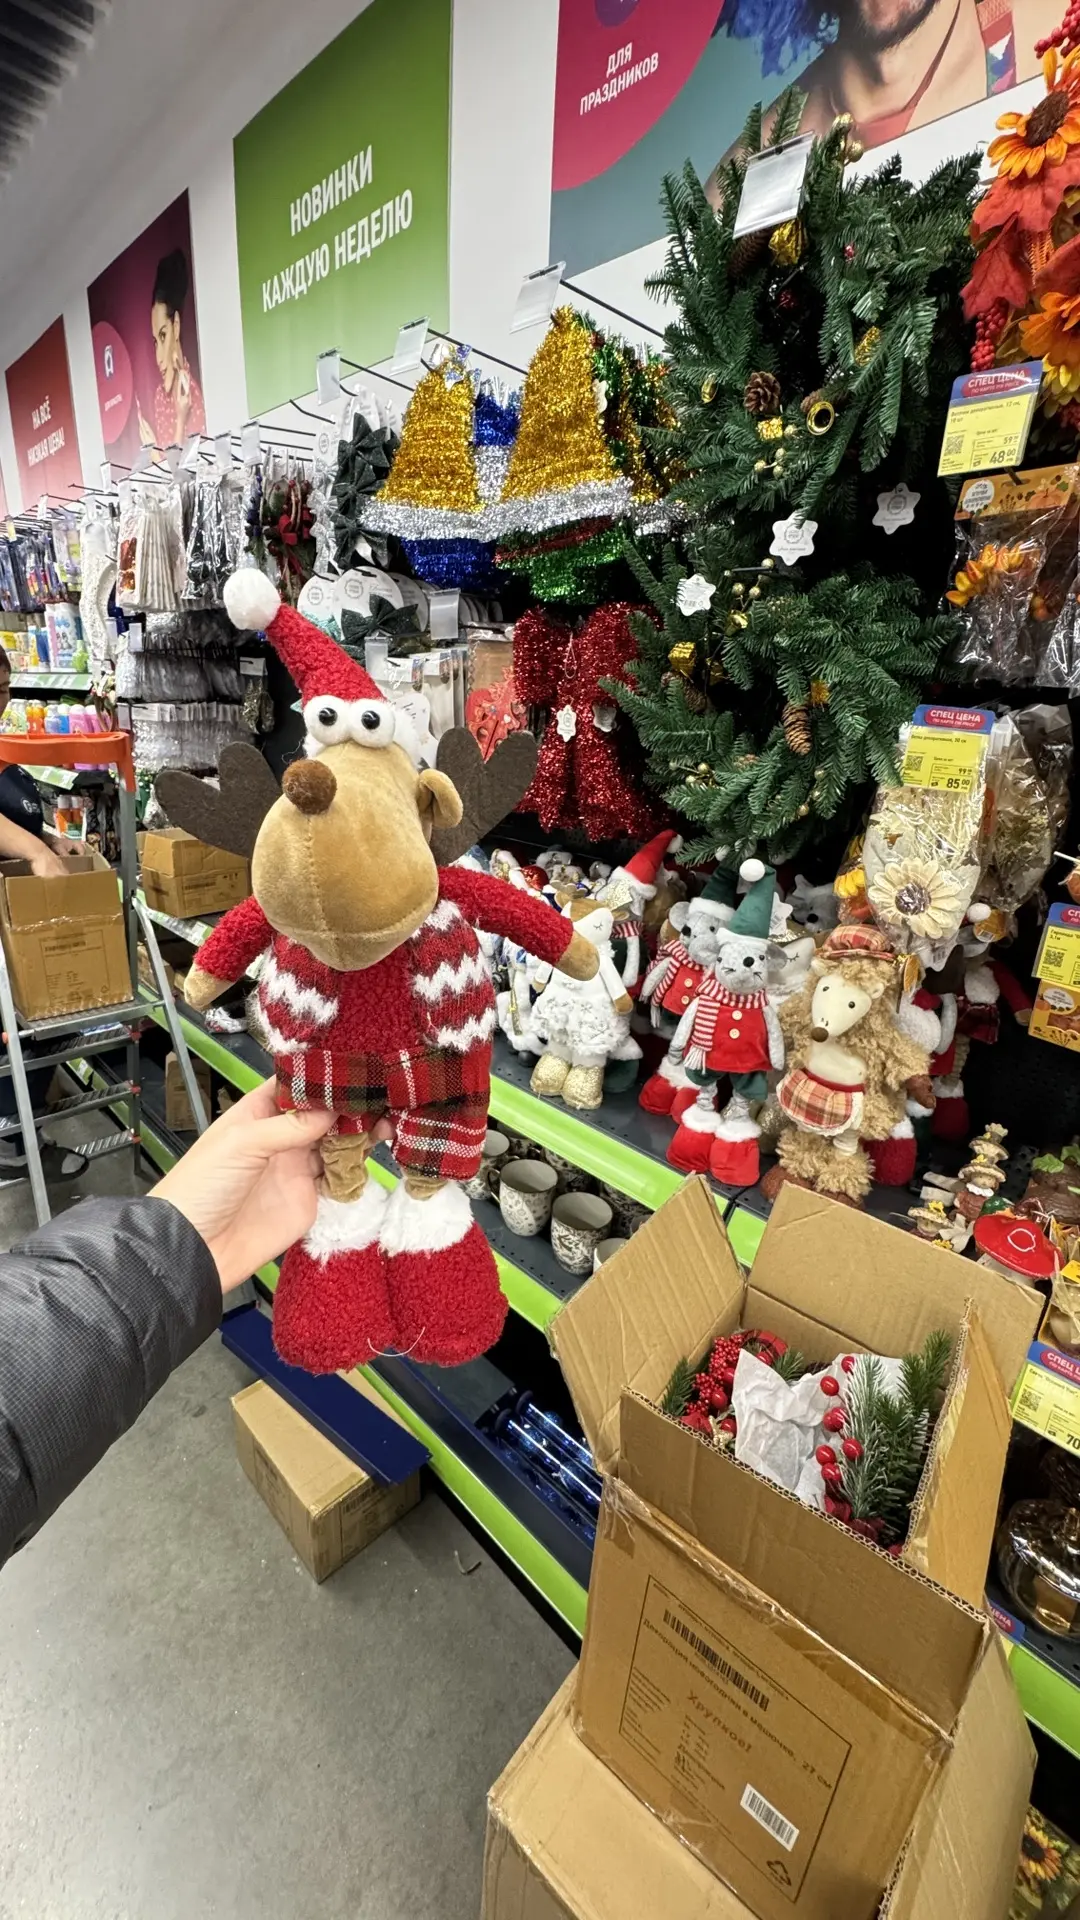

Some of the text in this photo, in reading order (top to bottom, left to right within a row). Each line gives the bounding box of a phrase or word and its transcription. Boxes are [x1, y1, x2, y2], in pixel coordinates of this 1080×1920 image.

[606, 42, 633, 78] ДЛЯ
[580, 52, 659, 115] ПРАЗДНИКОВ
[290, 144, 372, 237] НОВИНКИ
[262, 188, 413, 312] КАЖДУЮ НЕДЕЛЮ
[968, 374, 995, 388] СПЕЦ
[32, 395, 51, 430] НА ВСЁ
[27, 427, 65, 467] НИЗКАЯ ЦЕНА!
[989, 450, 1006, 464] 48
[930, 709, 981, 722] СПЕЦ ЦЕНА
[946, 777, 960, 789] 85
[1047, 1351, 1074, 1371] СПЕЦ
[1066, 1432, 1080, 1450] 70
[643, 1618, 688, 1663] Декорация
[689, 1661, 742, 1711] новогодняя
[802, 1761, 816, 1775] 27
[817, 1774, 833, 1790] см
[686, 1689, 753, 1753] Хрупкое!
